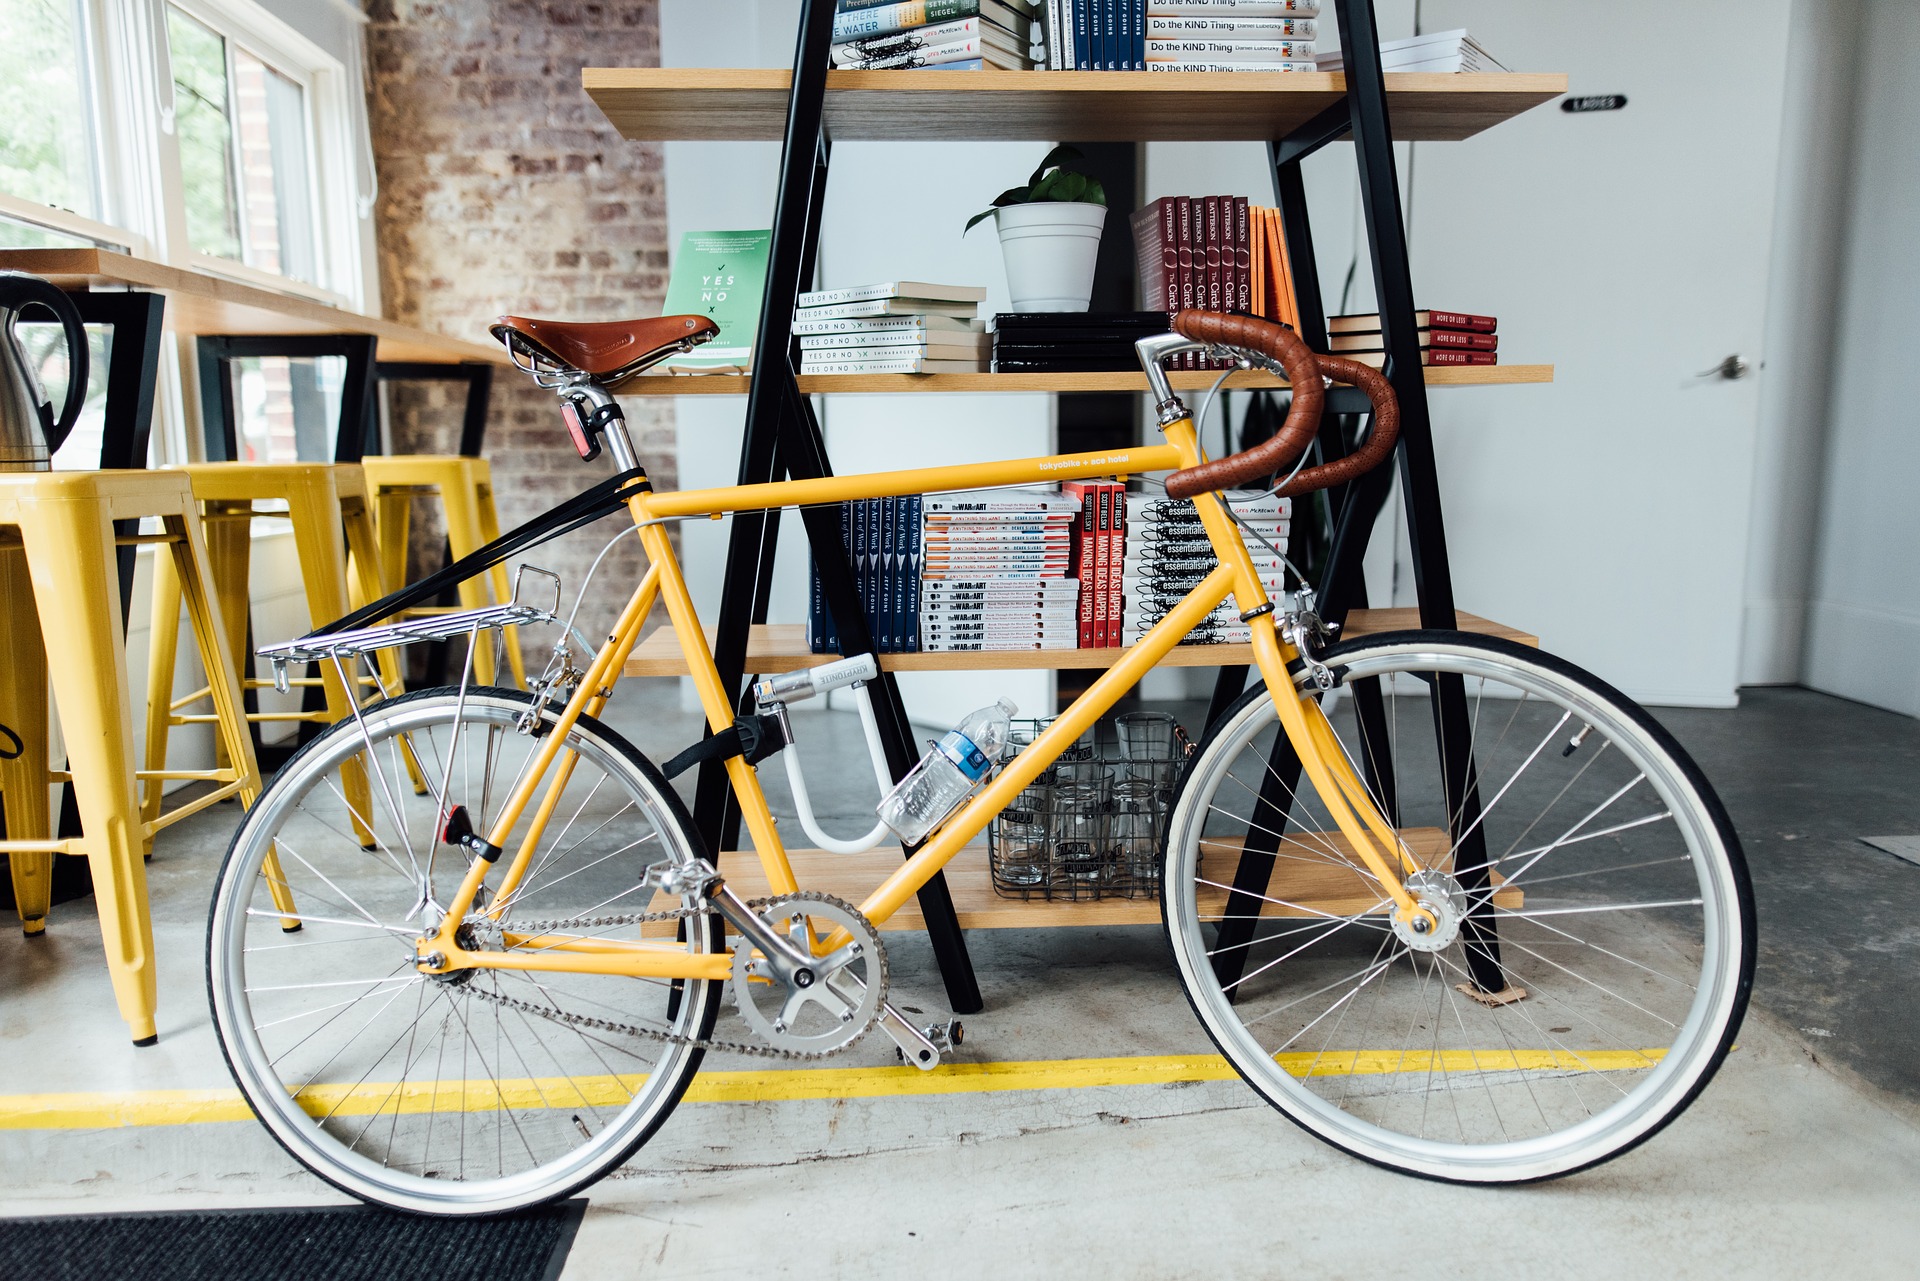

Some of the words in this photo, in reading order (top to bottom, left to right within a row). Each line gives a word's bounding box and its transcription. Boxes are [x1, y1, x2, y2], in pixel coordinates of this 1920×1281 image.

[847, 10, 879, 22] THERE
[930, 8, 956, 17] SIEGEL
[843, 21, 879, 35] WATER
[1153, 20, 1166, 29] Do
[1168, 20, 1183, 29] the
[1184, 20, 1208, 29] KIND
[1210, 20, 1235, 31] Thing
[1151, 42, 1164, 51] Do
[1166, 42, 1180, 51] the
[1182, 42, 1206, 51] KIND
[1208, 42, 1233, 54] Thing
[1152, 64, 1165, 72] Do
[1167, 64, 1181, 72] the
[1183, 64, 1207, 72] KIND
[1209, 64, 1234, 72] Thing
[1166, 203, 1174, 242] BATTERSON
[1181, 202, 1189, 241] BATTERSON
[1224, 201, 1232, 240] BATTERSON
[702, 275, 734, 286] YES
[701, 292, 727, 302] NO
[1168, 284, 1178, 310] Circle
[1183, 283, 1193, 309] Circle
[1197, 285, 1206, 310] Circle
[1210, 282, 1220, 309] Circle
[1225, 282, 1235, 308] Circle
[1239, 284, 1249, 310] Circle
[1436, 315, 1449, 323] MORE
[1456, 316, 1466, 324] LESS
[1456, 336, 1467, 344] LESS
[1039, 456, 1080, 471] tokyobike
[1090, 457, 1105, 465] ace
[1108, 454, 1129, 464] hotel
[1114, 509, 1122, 529] BELSKY
[1168, 506, 1198, 515] essentia
[884, 531, 892, 549] Work
[1168, 526, 1206, 535] essentialis
[857, 533, 865, 551] Work
[898, 533, 906, 551] Work
[911, 532, 919, 550] Work
[1097, 535, 1109, 566] MAKING
[1111, 535, 1123, 566] MAKING
[1167, 544, 1211, 553] essentialism
[1083, 537, 1093, 567] MAKING
[1164, 561, 1208, 570] essentialism
[1082, 569, 1093, 591] IDEAS
[1096, 567, 1108, 590] IDEAS
[1110, 567, 1122, 589] IDEAS
[1082, 592, 1093, 622] HAPPEN
[1096, 591, 1107, 621] HAPPEN
[1109, 590, 1121, 620] HAPPEN
[821, 665, 868, 684] KRYPTONITE
